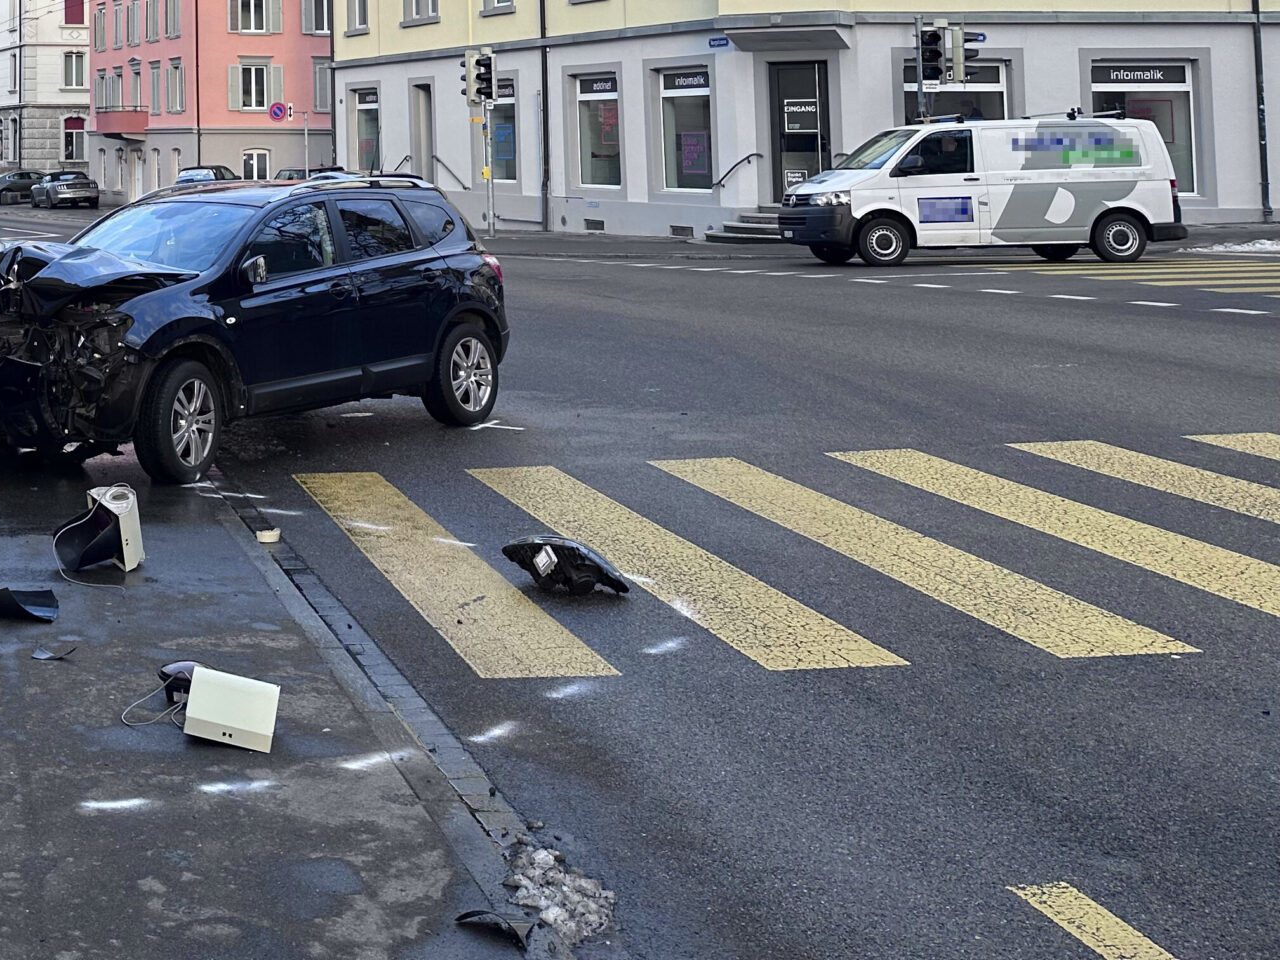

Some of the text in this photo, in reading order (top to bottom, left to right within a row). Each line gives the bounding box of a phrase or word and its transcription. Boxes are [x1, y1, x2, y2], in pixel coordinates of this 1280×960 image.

[675, 74, 705, 86] informatik
[1110, 69, 1164, 80] informatik
[784, 105, 816, 113] EINGANG
